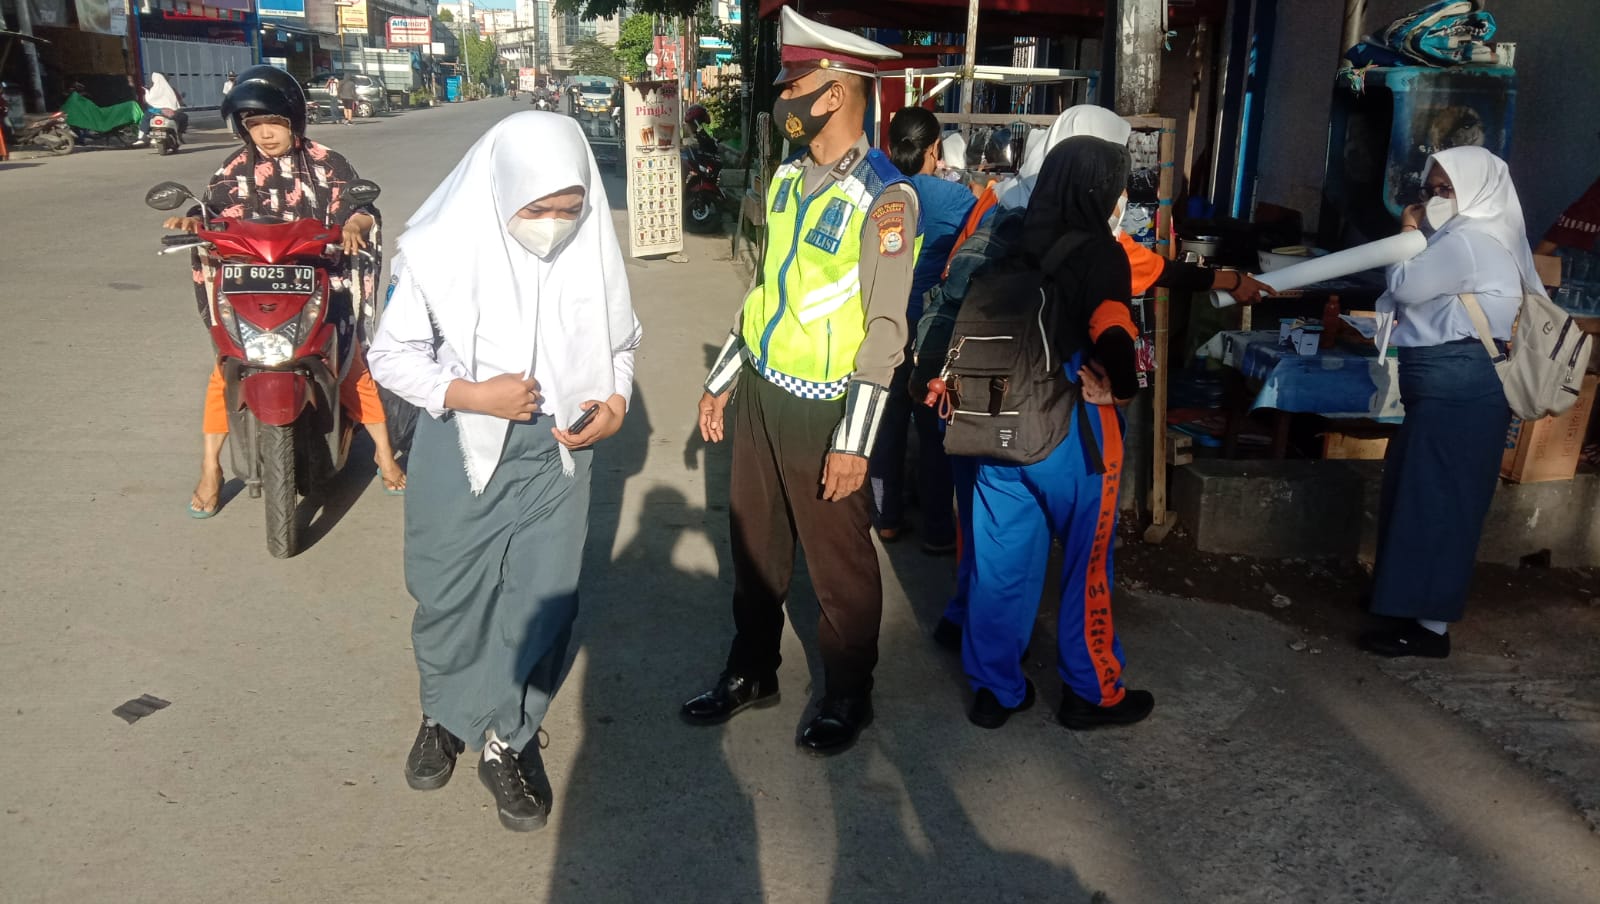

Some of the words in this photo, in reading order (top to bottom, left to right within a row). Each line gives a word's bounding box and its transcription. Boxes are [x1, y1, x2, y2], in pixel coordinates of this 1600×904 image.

[392, 19, 426, 28] Alfamart
[807, 230, 838, 252] POLISI
[224, 266, 242, 279] DD
[250, 267, 285, 279] 6025
[294, 268, 312, 280] VD
[1088, 581, 1105, 599] 04
